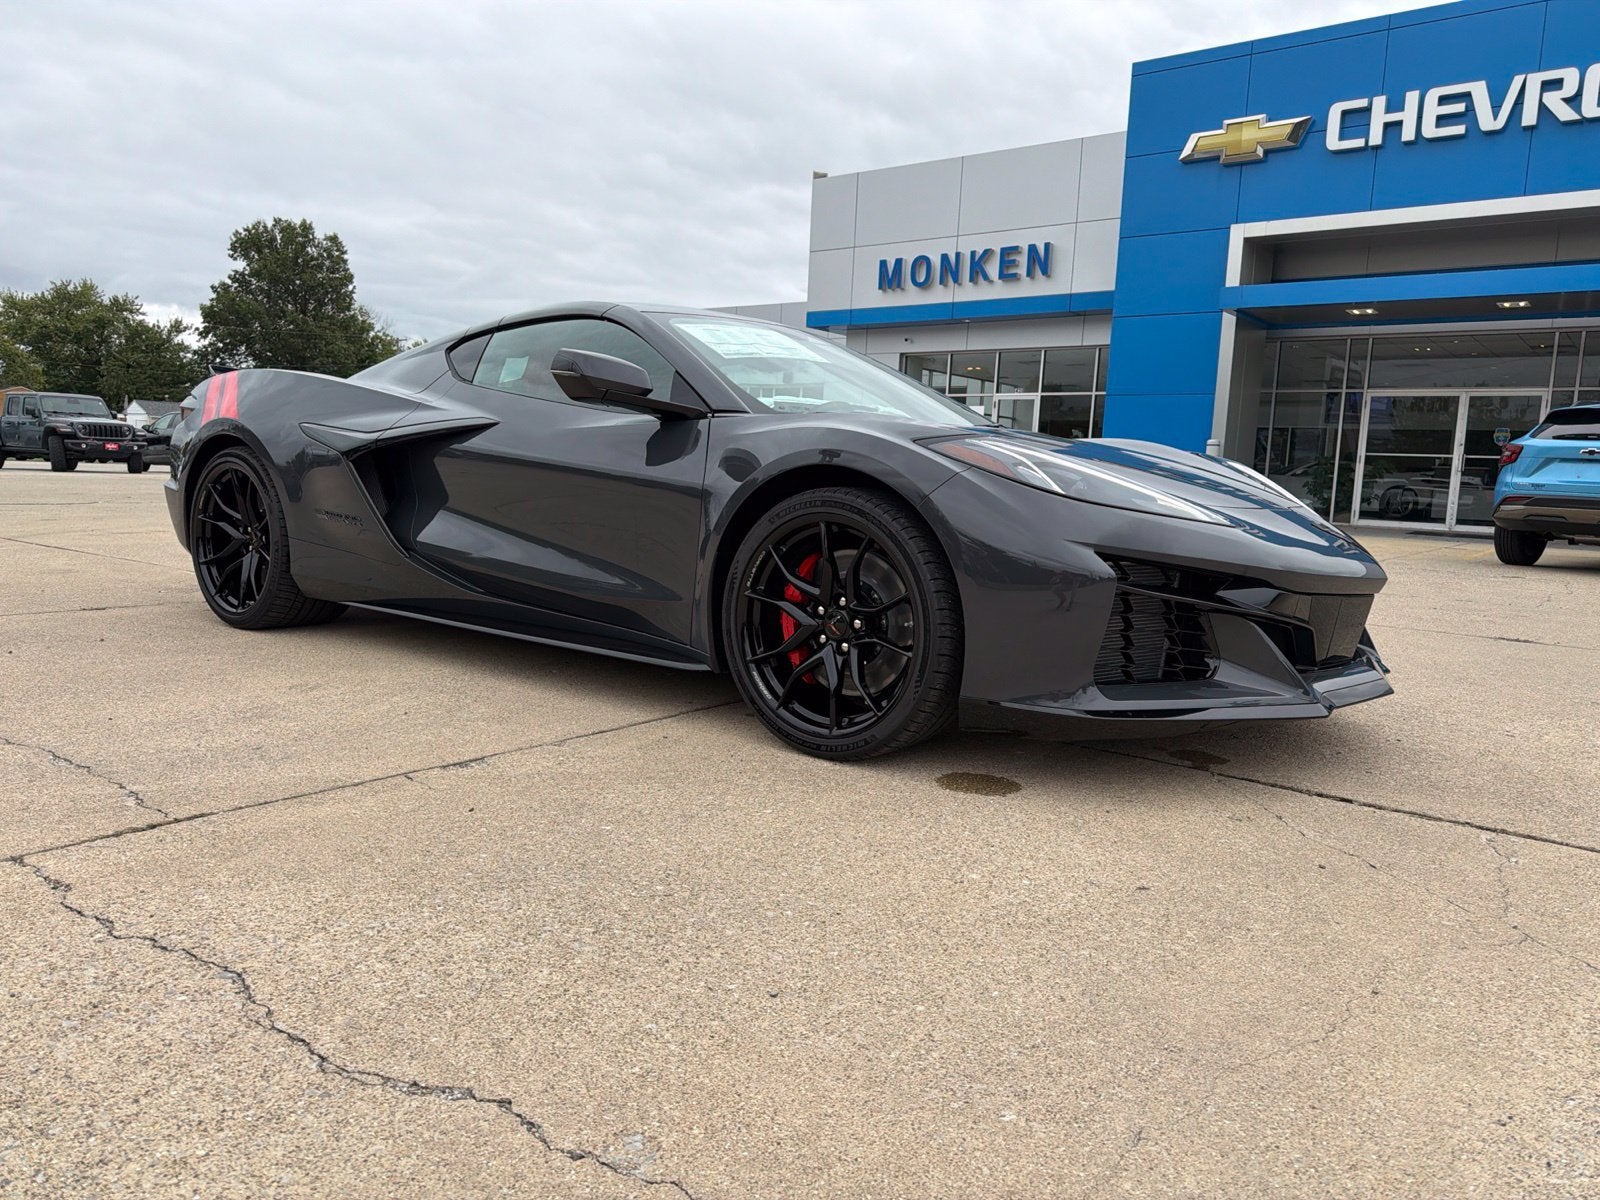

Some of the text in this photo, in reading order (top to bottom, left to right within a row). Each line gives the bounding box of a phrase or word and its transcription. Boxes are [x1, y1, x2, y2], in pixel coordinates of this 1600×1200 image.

[878, 242, 1053, 291] MONKEN
[778, 500, 822, 518] MICHELIN
[816, 739, 865, 753] MICHELIN
